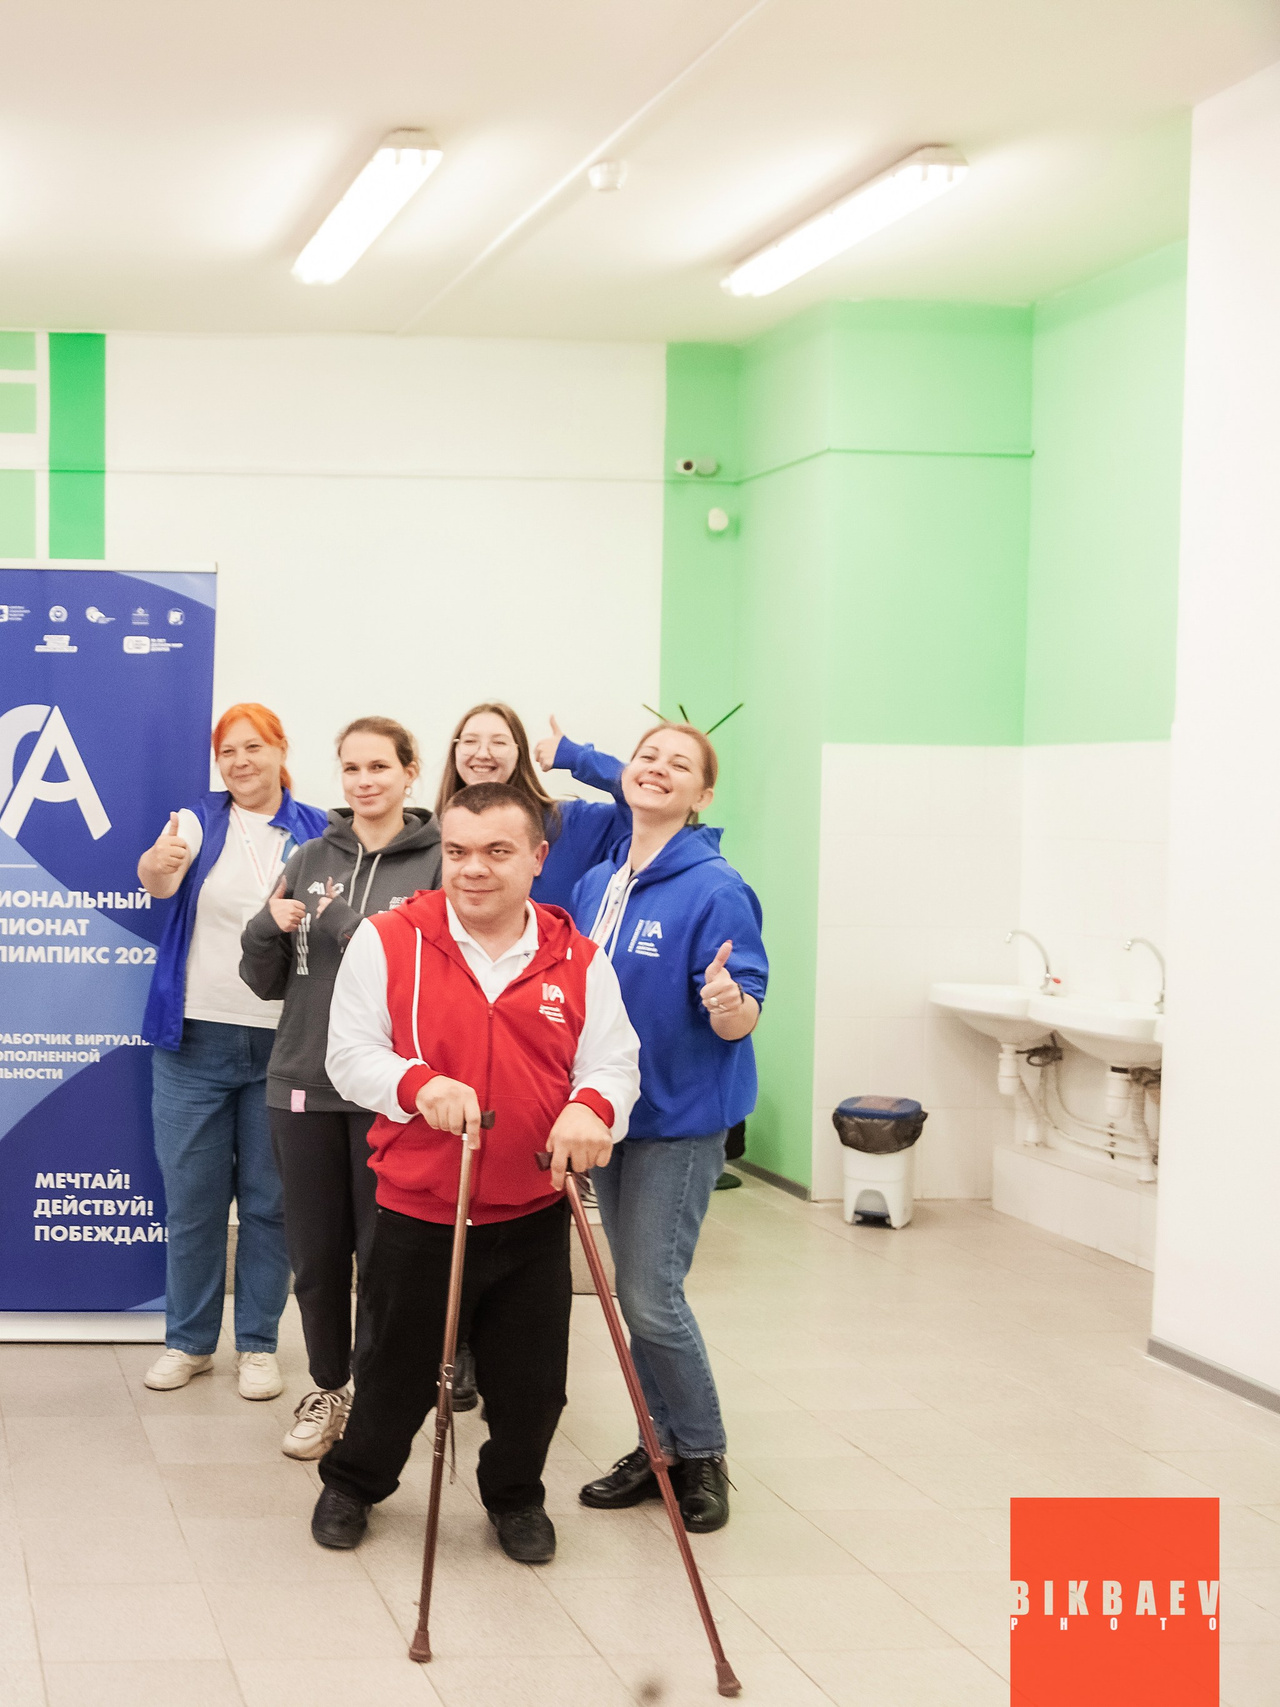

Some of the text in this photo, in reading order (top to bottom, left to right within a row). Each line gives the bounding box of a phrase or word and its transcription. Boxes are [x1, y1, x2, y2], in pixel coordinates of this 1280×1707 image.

[115, 946, 157, 965] 202
[75, 1034, 154, 1046] ВИРТУАЛЬ
[35, 1168, 131, 1190] МЕЧТАЙ!
[33, 1194, 154, 1218] ДЕЙСТВУЙ!
[34, 1222, 169, 1245] ПОБЕЖДАЙ!
